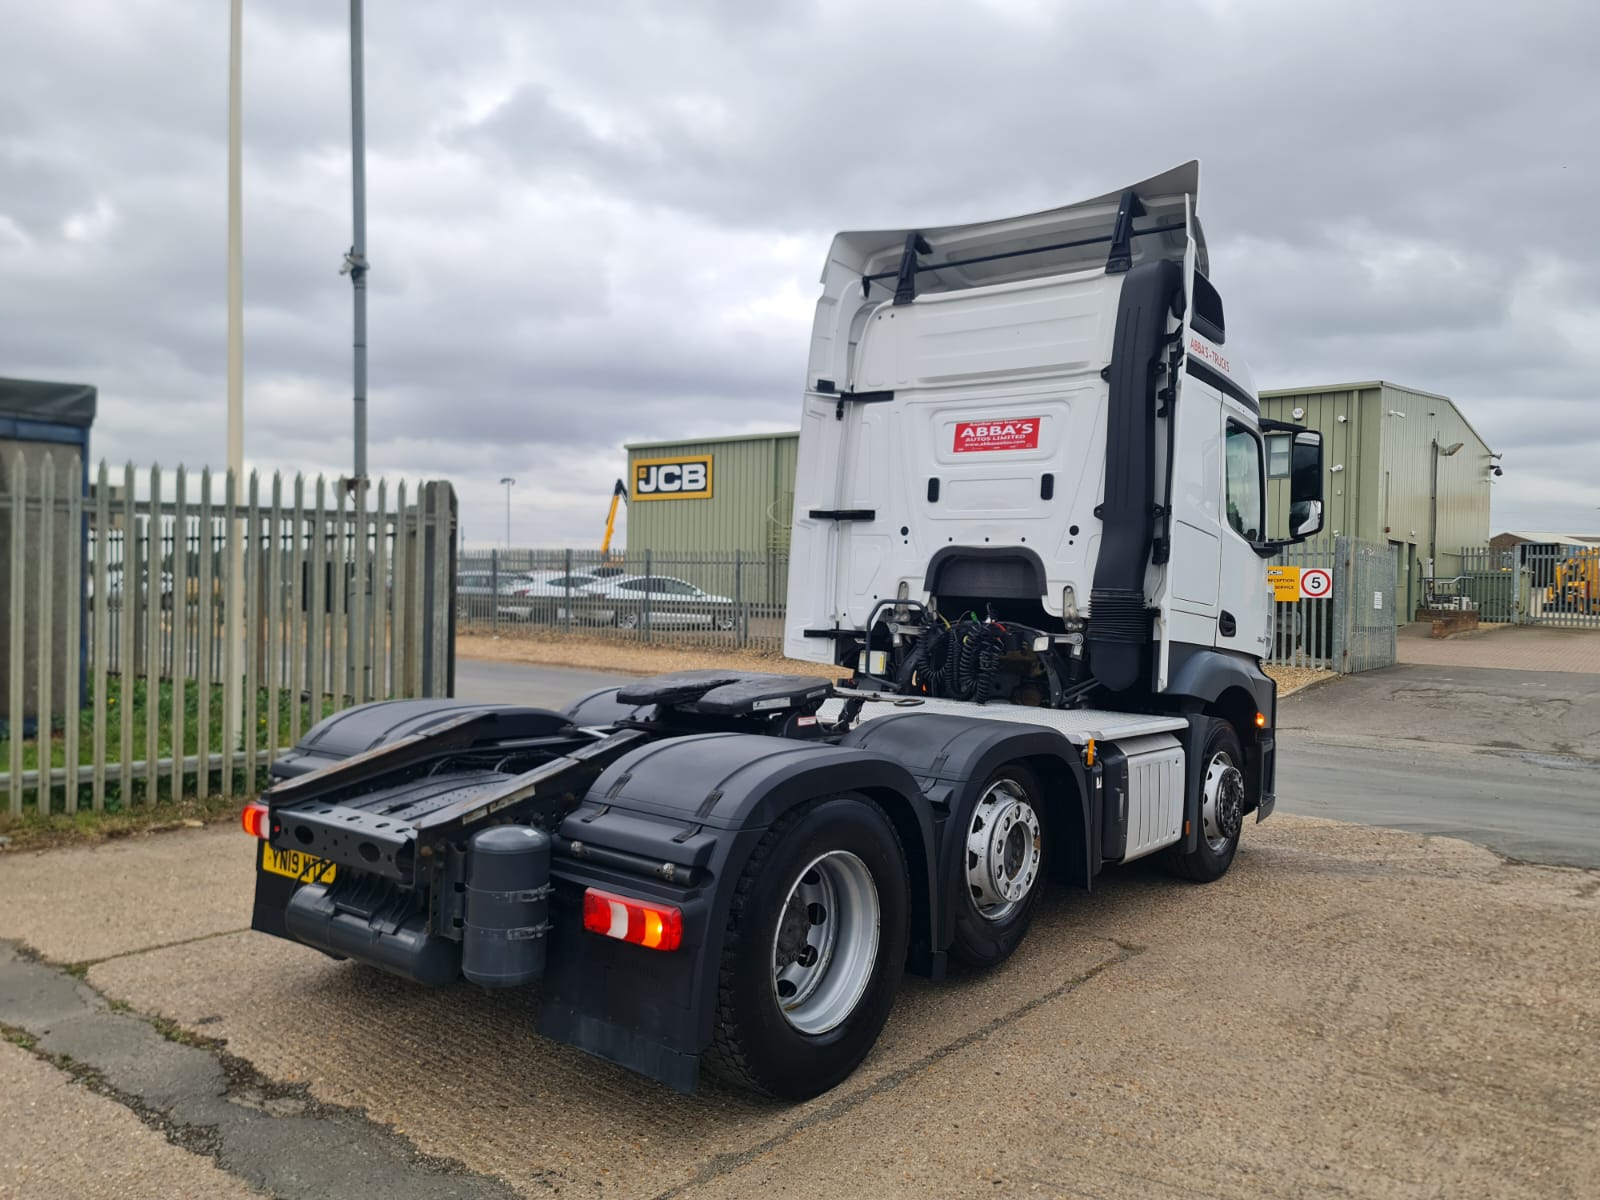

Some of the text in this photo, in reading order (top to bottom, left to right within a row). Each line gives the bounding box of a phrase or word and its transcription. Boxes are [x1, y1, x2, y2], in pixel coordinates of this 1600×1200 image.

[960, 423, 1033, 438] ABBA'S
[638, 463, 706, 493] JCB
[1311, 576, 1321, 589] 5
[273, 849, 299, 874] YN19
